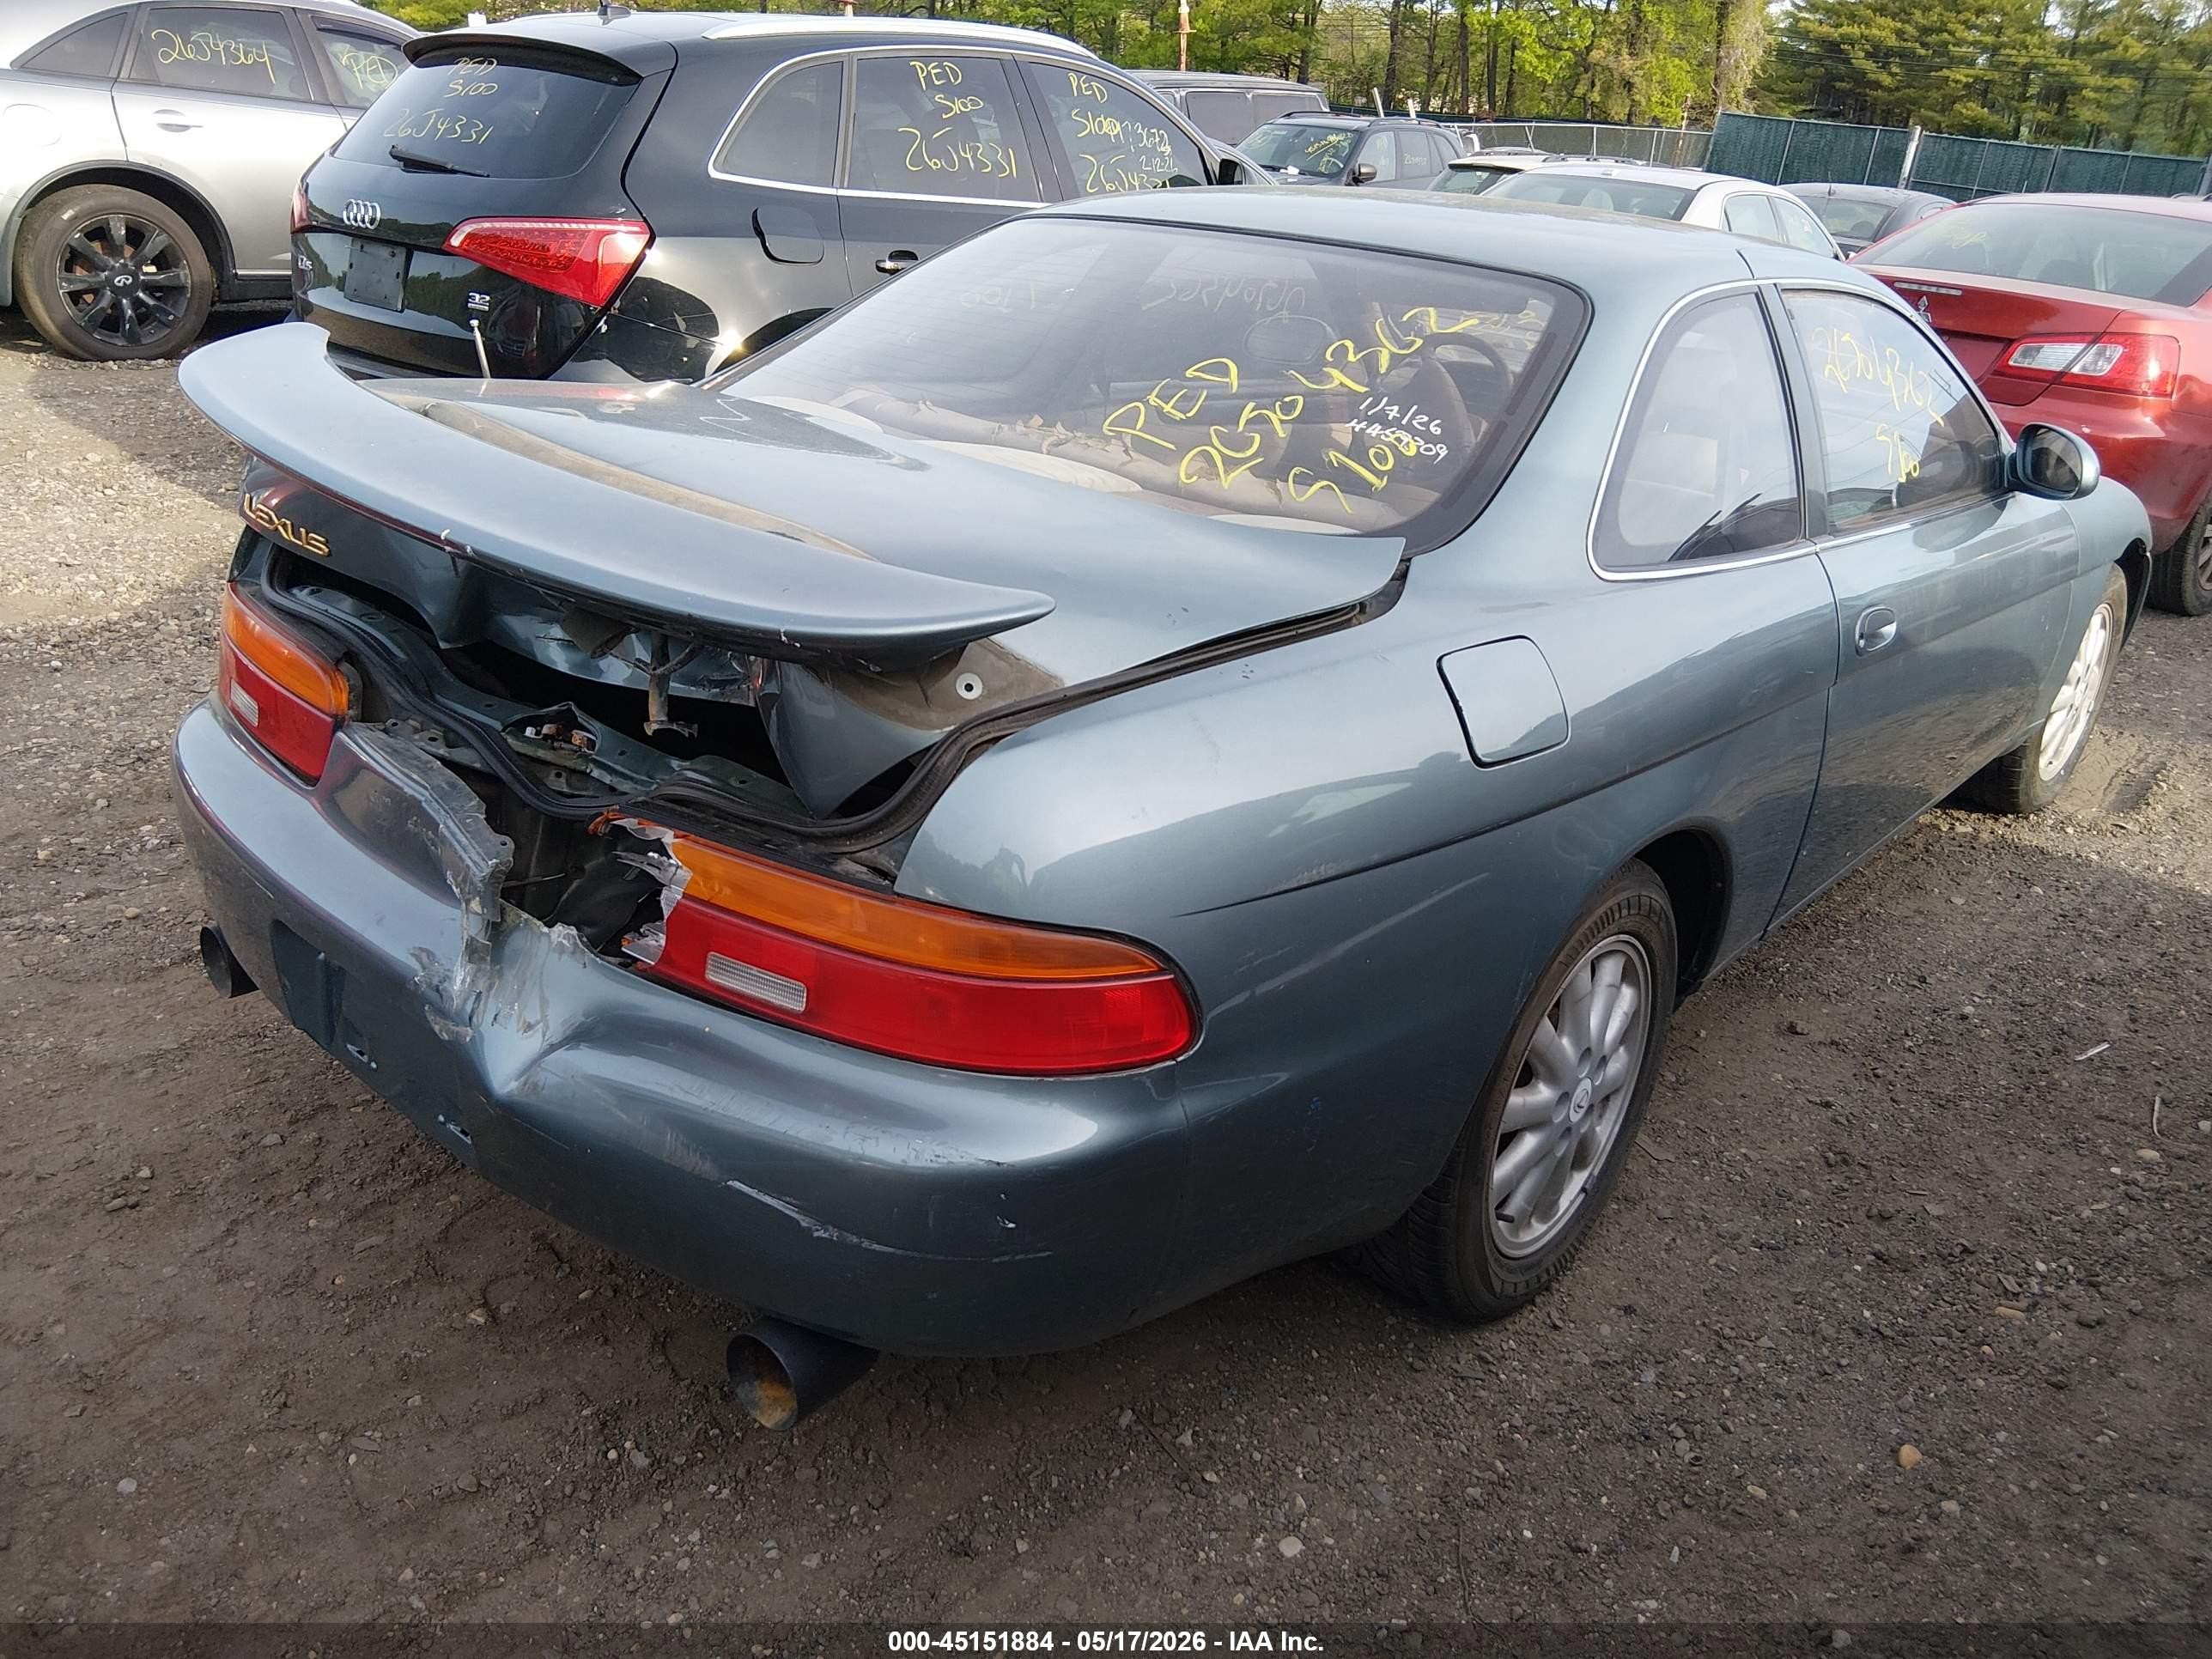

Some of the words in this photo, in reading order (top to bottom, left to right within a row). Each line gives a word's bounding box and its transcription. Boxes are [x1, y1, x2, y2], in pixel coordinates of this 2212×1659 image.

[343, 52, 398, 89] PED
[447, 57, 498, 76] PED
[909, 62, 963, 91] PED
[1068, 73, 1108, 103] PED
[1103, 357, 1239, 450] PED
[244, 493, 331, 556] LEXUS
